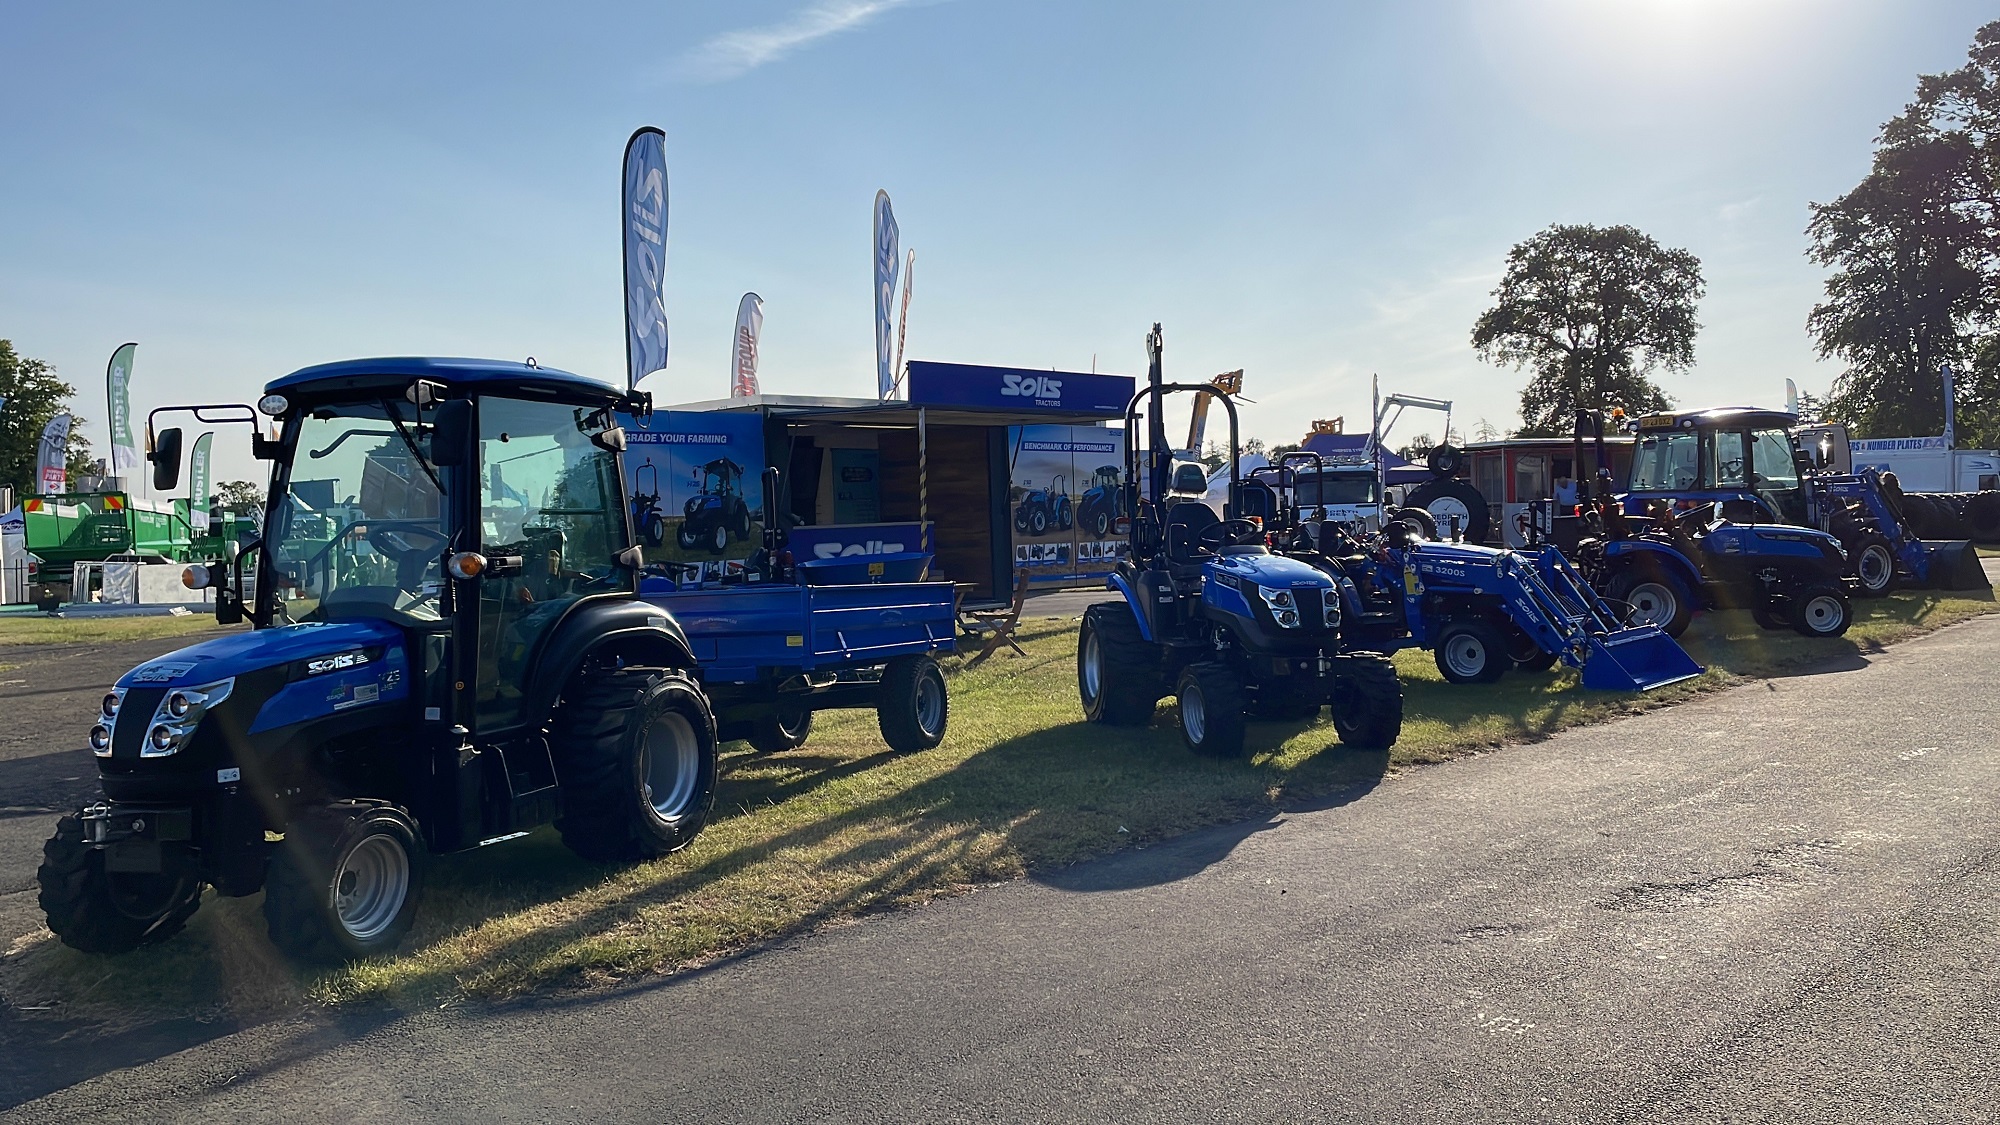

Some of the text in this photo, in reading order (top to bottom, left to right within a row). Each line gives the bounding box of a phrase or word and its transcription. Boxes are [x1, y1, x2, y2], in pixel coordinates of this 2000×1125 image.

[113, 366, 126, 438] HUSTLER
[660, 433, 685, 443] YOUR
[688, 435, 727, 444] FARMING
[1024, 442, 1062, 450] BENCHMARK
[1073, 444, 1113, 452] PERFORMANCE
[1867, 441, 1895, 450] NUMBER
[1897, 440, 1922, 449] PLATES
[45, 473, 64, 481] PARTS
[194, 451, 205, 506] HUSTLER
[1436, 567, 1465, 577] 3200S
